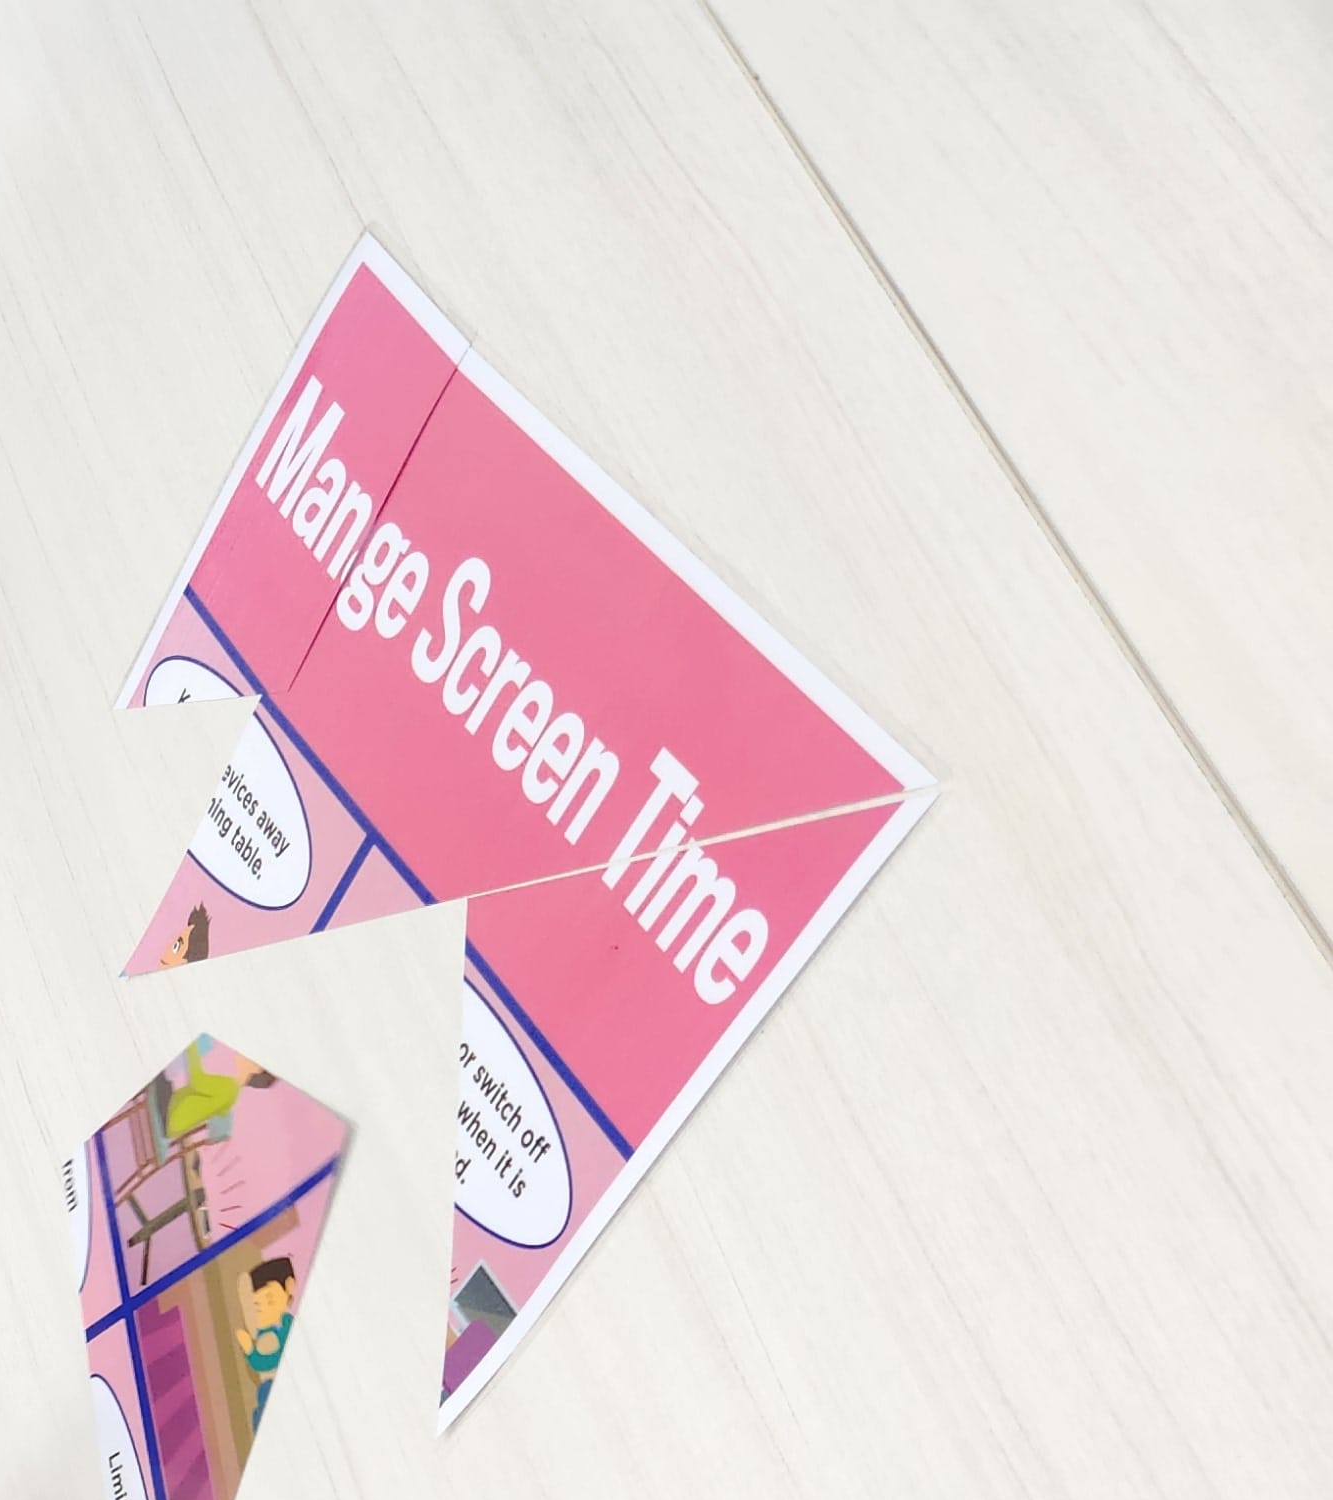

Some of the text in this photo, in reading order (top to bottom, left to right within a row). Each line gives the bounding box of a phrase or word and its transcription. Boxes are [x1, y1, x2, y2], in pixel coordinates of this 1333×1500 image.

[255, 374, 769, 1006] Mange Screen Time
[230, 825, 262, 880] table.
[253, 810, 291, 858] away
[456, 1100, 527, 1199] when it is
[472, 1065, 525, 1129] switch
[519, 1128, 552, 1164] off
